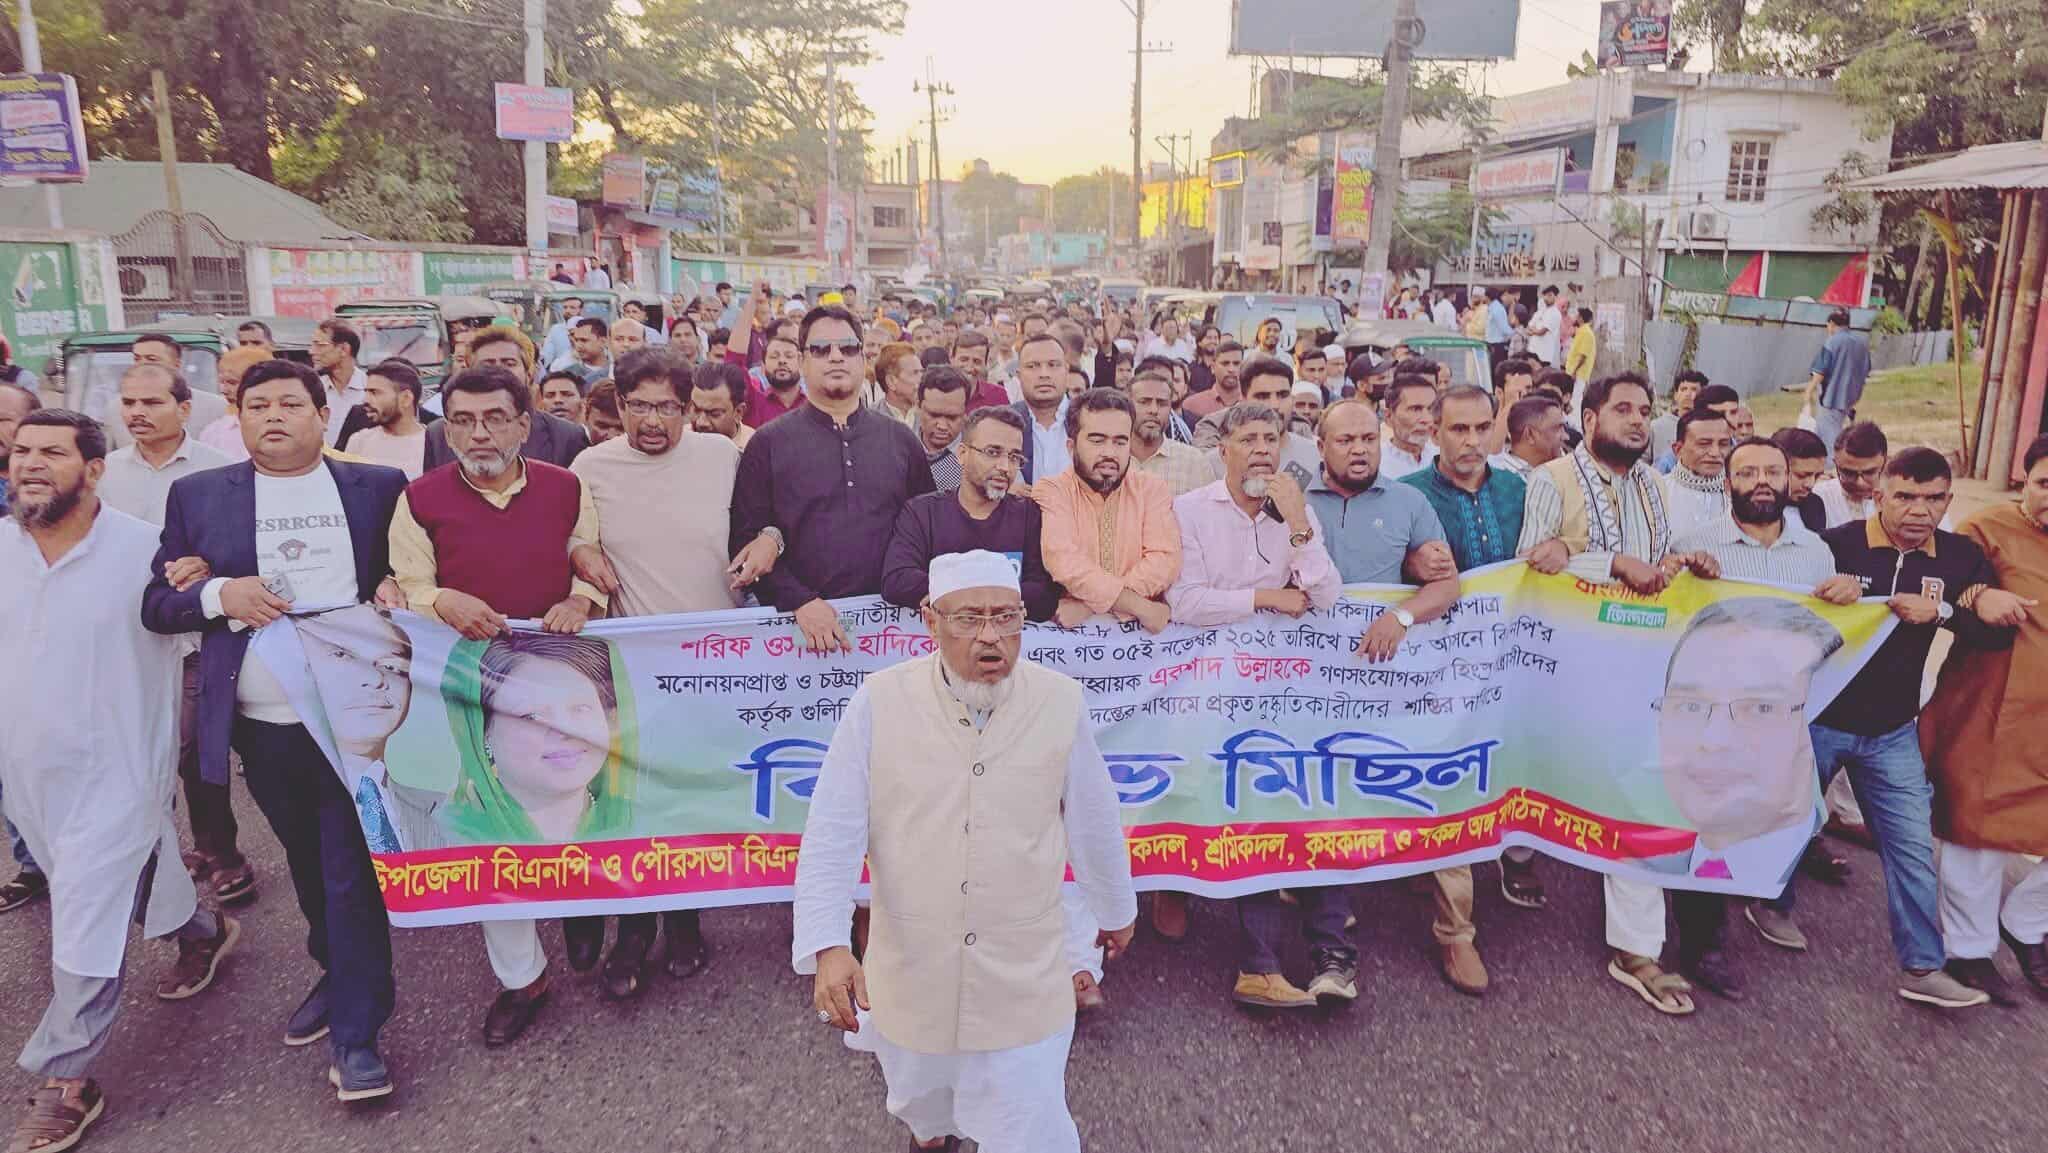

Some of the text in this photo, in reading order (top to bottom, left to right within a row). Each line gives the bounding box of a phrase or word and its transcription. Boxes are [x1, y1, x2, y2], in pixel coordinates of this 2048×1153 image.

[680, 633, 753, 660] শরিফ
[856, 625, 939, 657] হাদিকে
[1027, 646, 1067, 665] এবং
[1074, 645, 1105, 663] গত
[1112, 637, 1155, 661] ০৫ই
[1159, 629, 1219, 657] নভেম্বর
[1225, 627, 1276, 649] ২০২৫
[1280, 623, 1342, 651] তারিখে
[654, 672, 789, 694] মনোনয়নপ্রাপ্ত
[796, 674, 812, 690] ও
[818, 666, 873, 690] চট্টগ্রা
[1072, 674, 1144, 695] হ্বায়ক
[735, 701, 795, 732] কর্তৃক
[1088, 704, 1138, 725] দন্তের
[1206, 693, 1256, 722] প্রকৃত
[1207, 728, 1500, 814] মিছিল
[491, 843, 593, 890] বিএনপি
[601, 853, 622, 883] ও
[631, 837, 737, 883] পৌরসভা
[742, 834, 801, 876] বিএন
[1125, 832, 1199, 872] কদল,
[1304, 828, 1388, 871] কৃষকদল
[1392, 829, 1412, 852] ও
[1416, 820, 1466, 849] সকল
